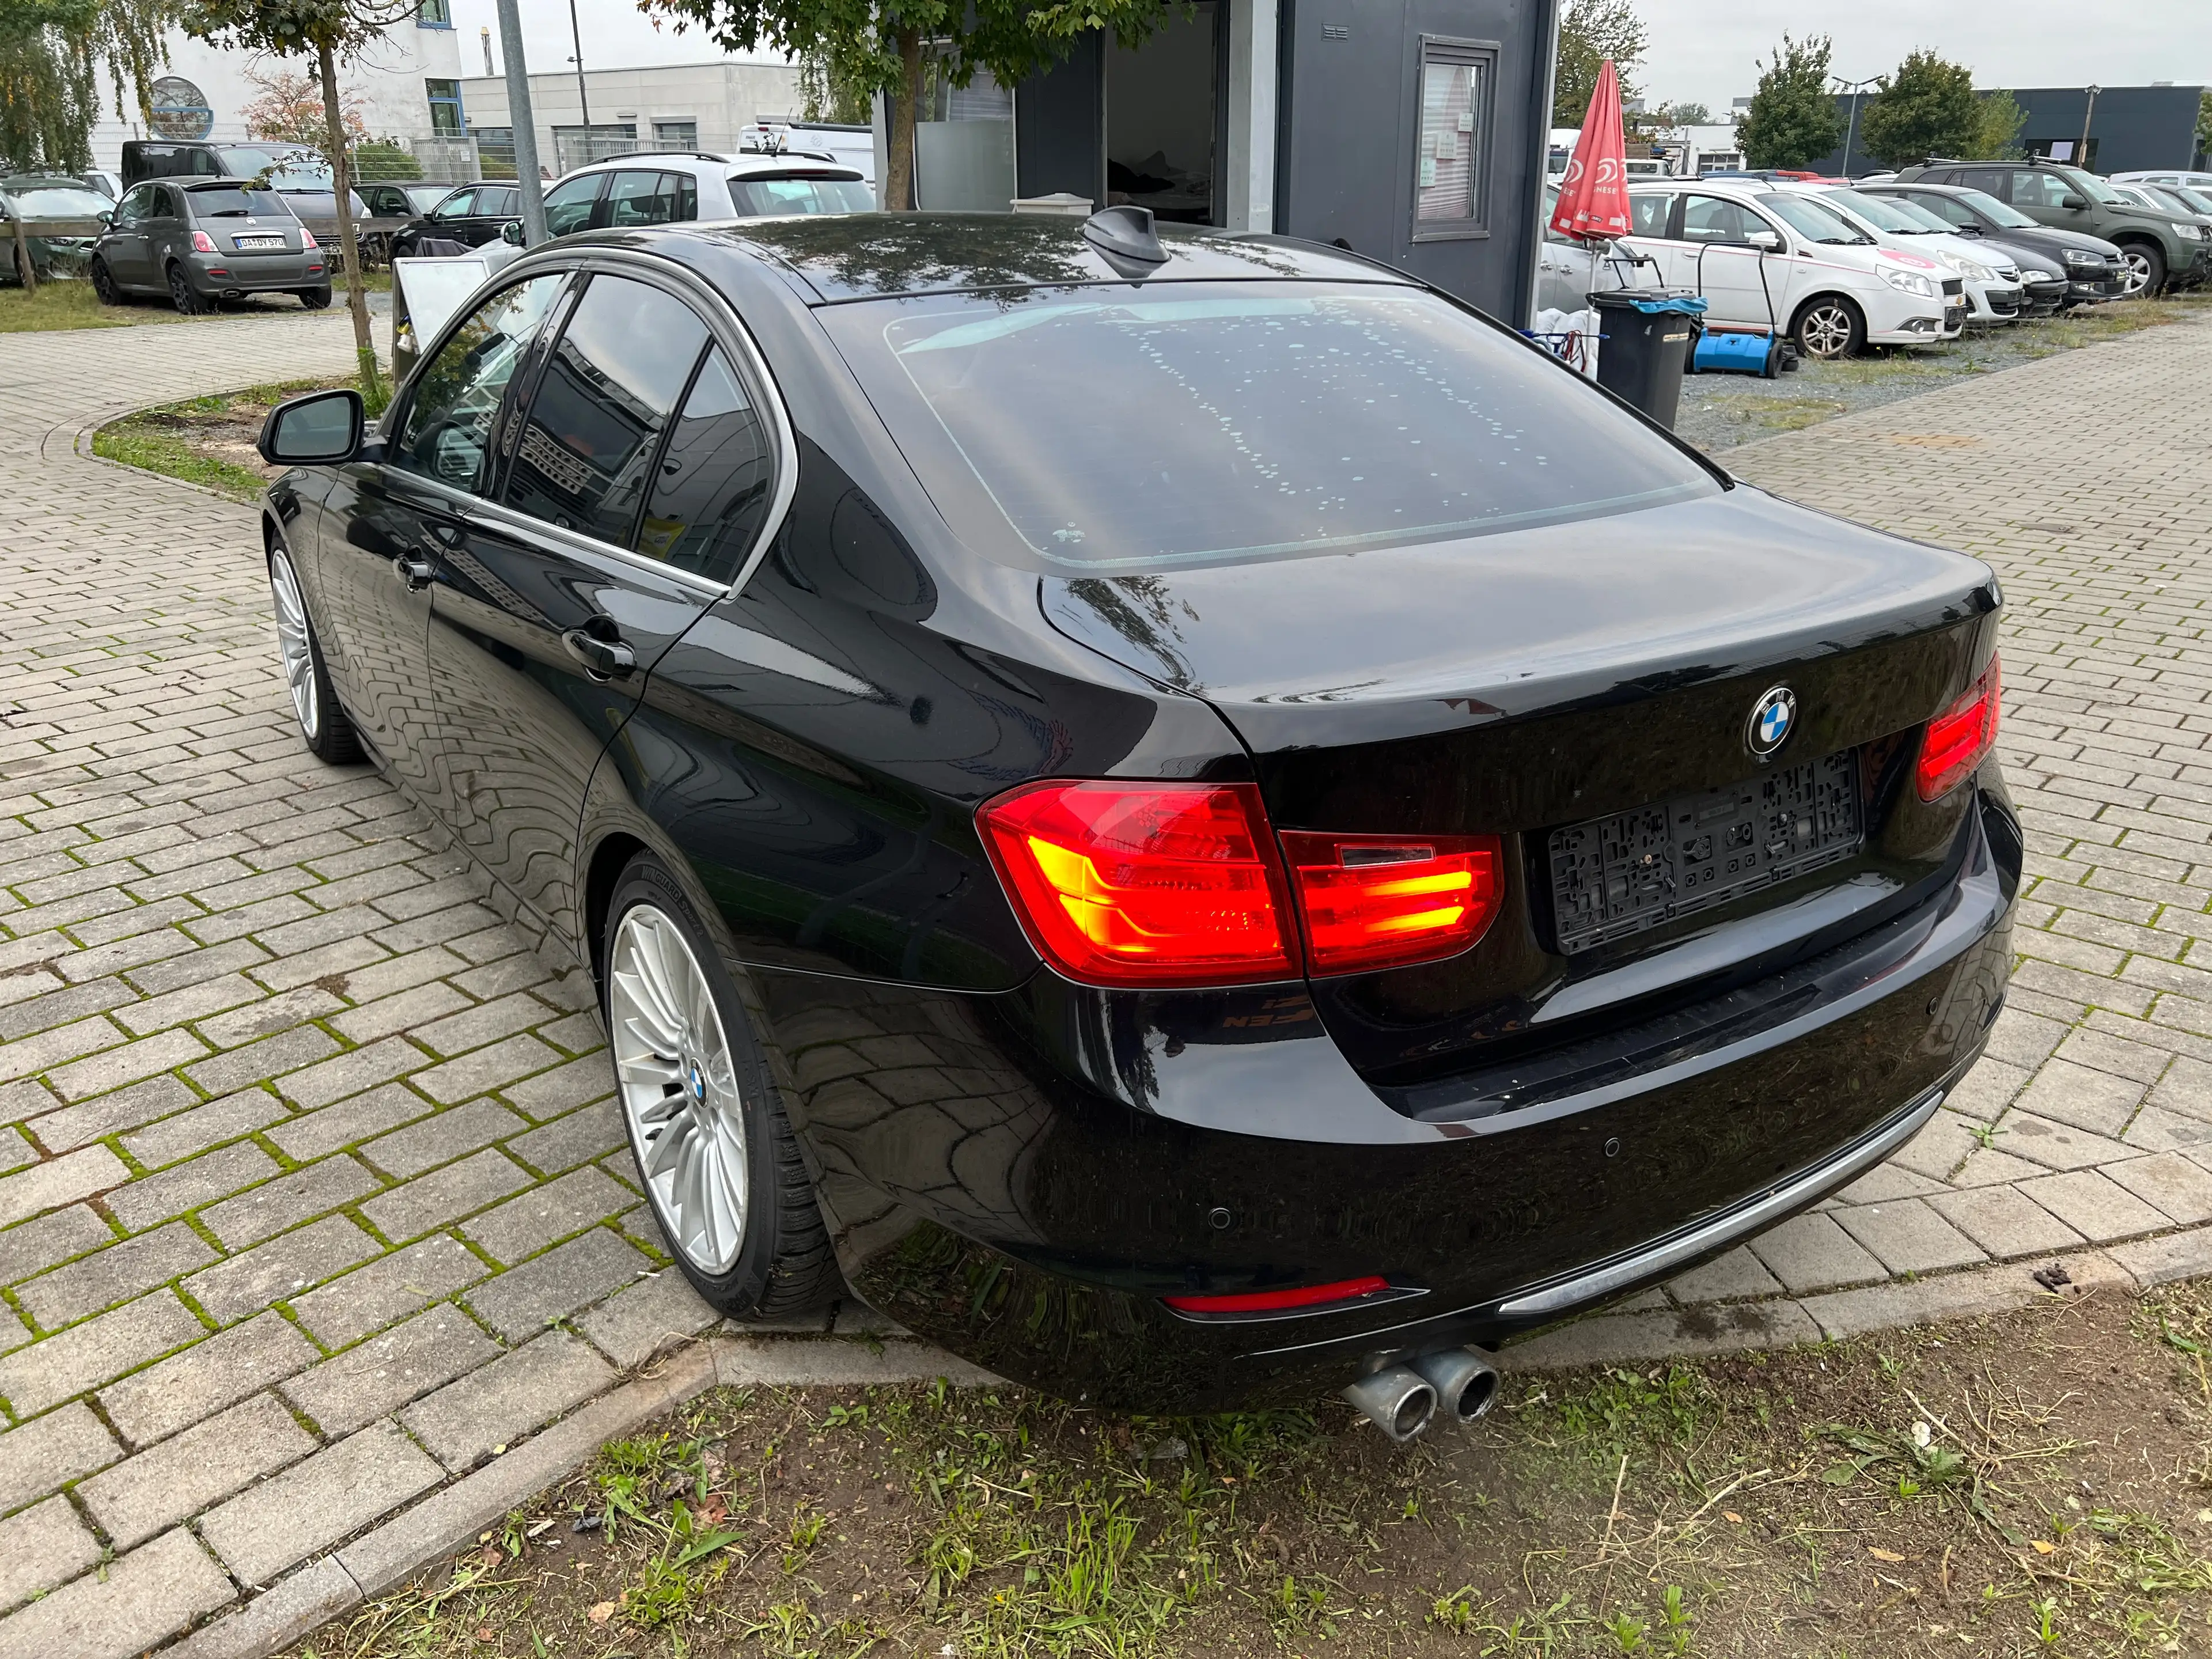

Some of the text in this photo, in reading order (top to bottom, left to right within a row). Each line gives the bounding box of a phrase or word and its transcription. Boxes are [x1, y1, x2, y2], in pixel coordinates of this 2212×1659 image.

[1760, 690, 1796, 715] BMW
[641, 865, 683, 902] WINGUARD
[678, 900, 701, 928] Sport
